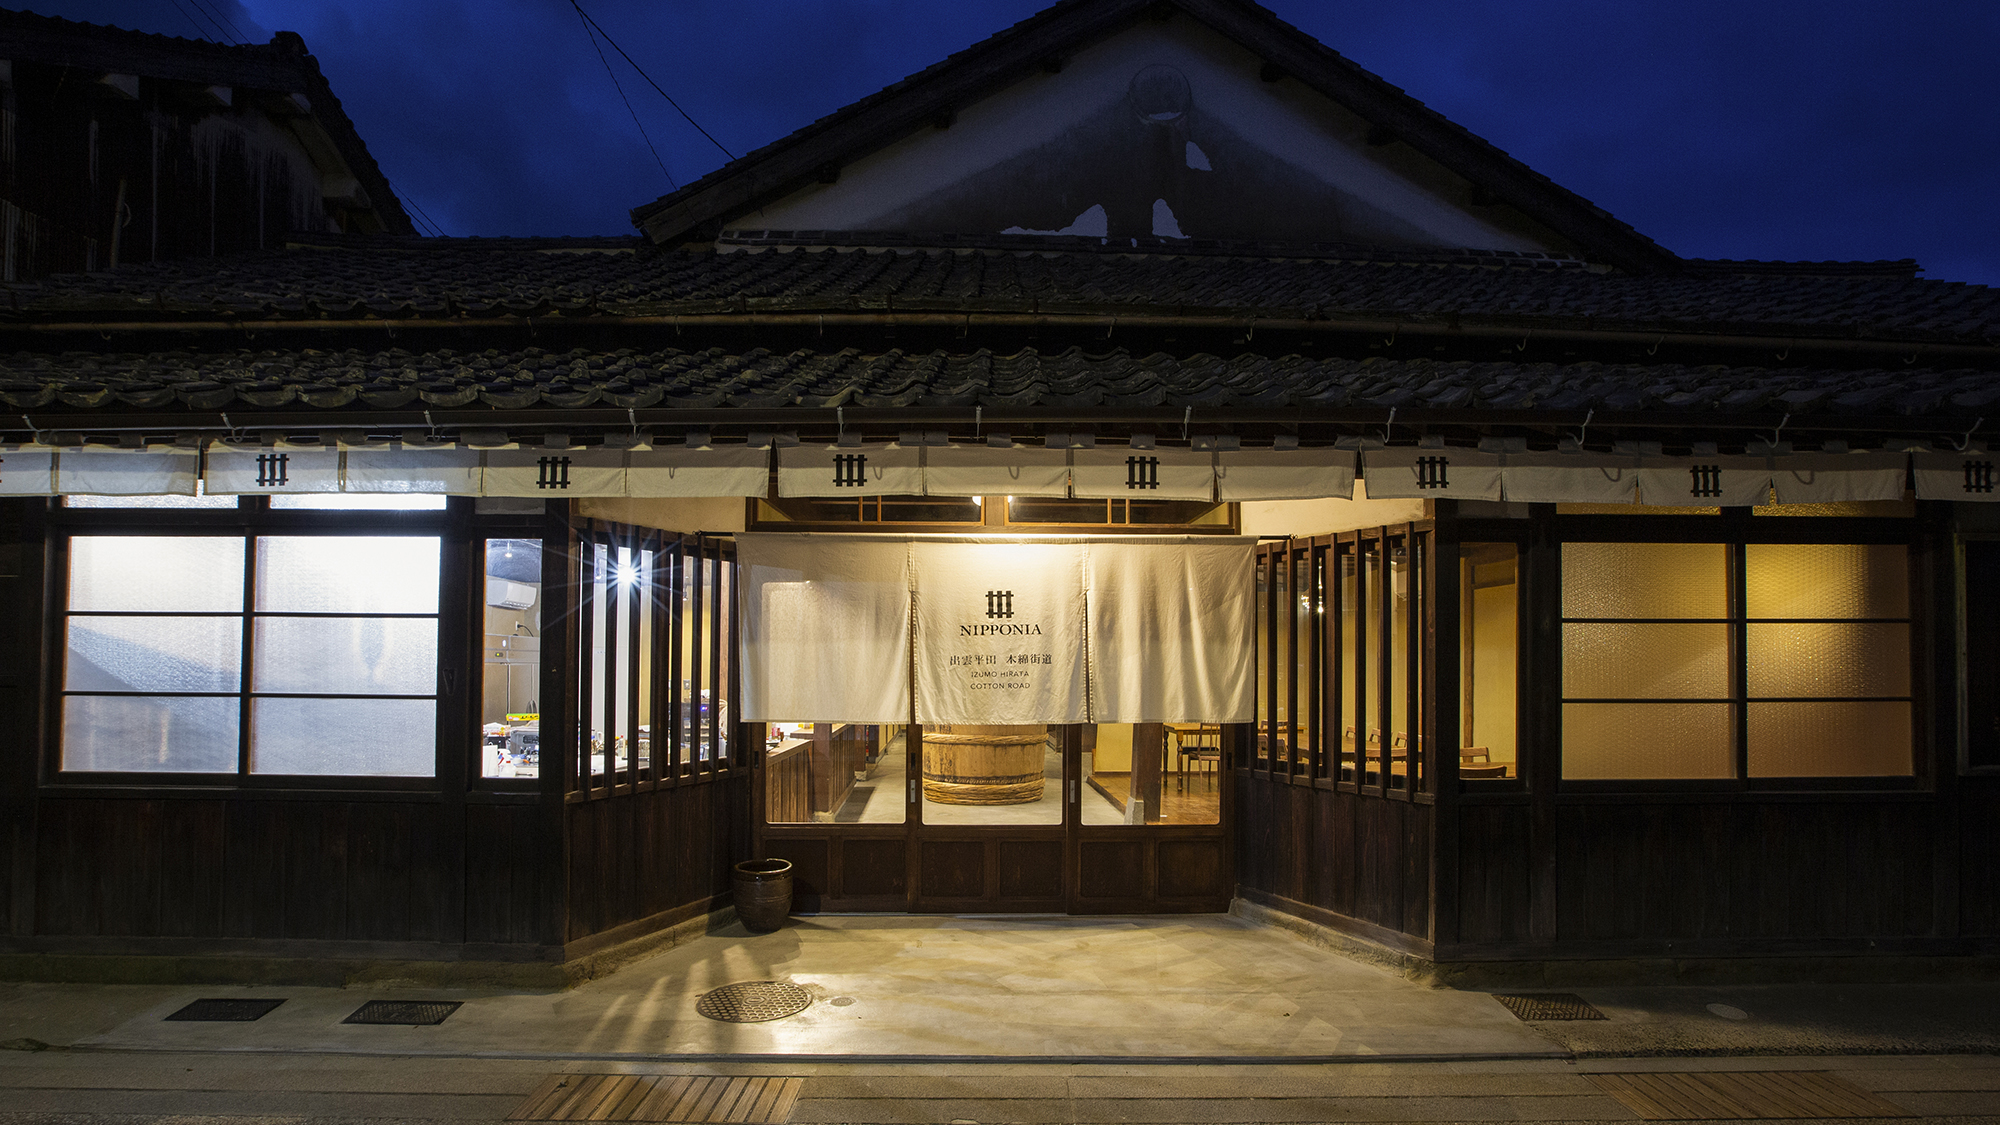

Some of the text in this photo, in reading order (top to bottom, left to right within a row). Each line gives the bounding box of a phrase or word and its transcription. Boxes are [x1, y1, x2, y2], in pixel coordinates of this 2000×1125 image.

[960, 624, 1042, 636] NIPPONIA
[949, 653, 1052, 666] 出雲平田 木綿街道
